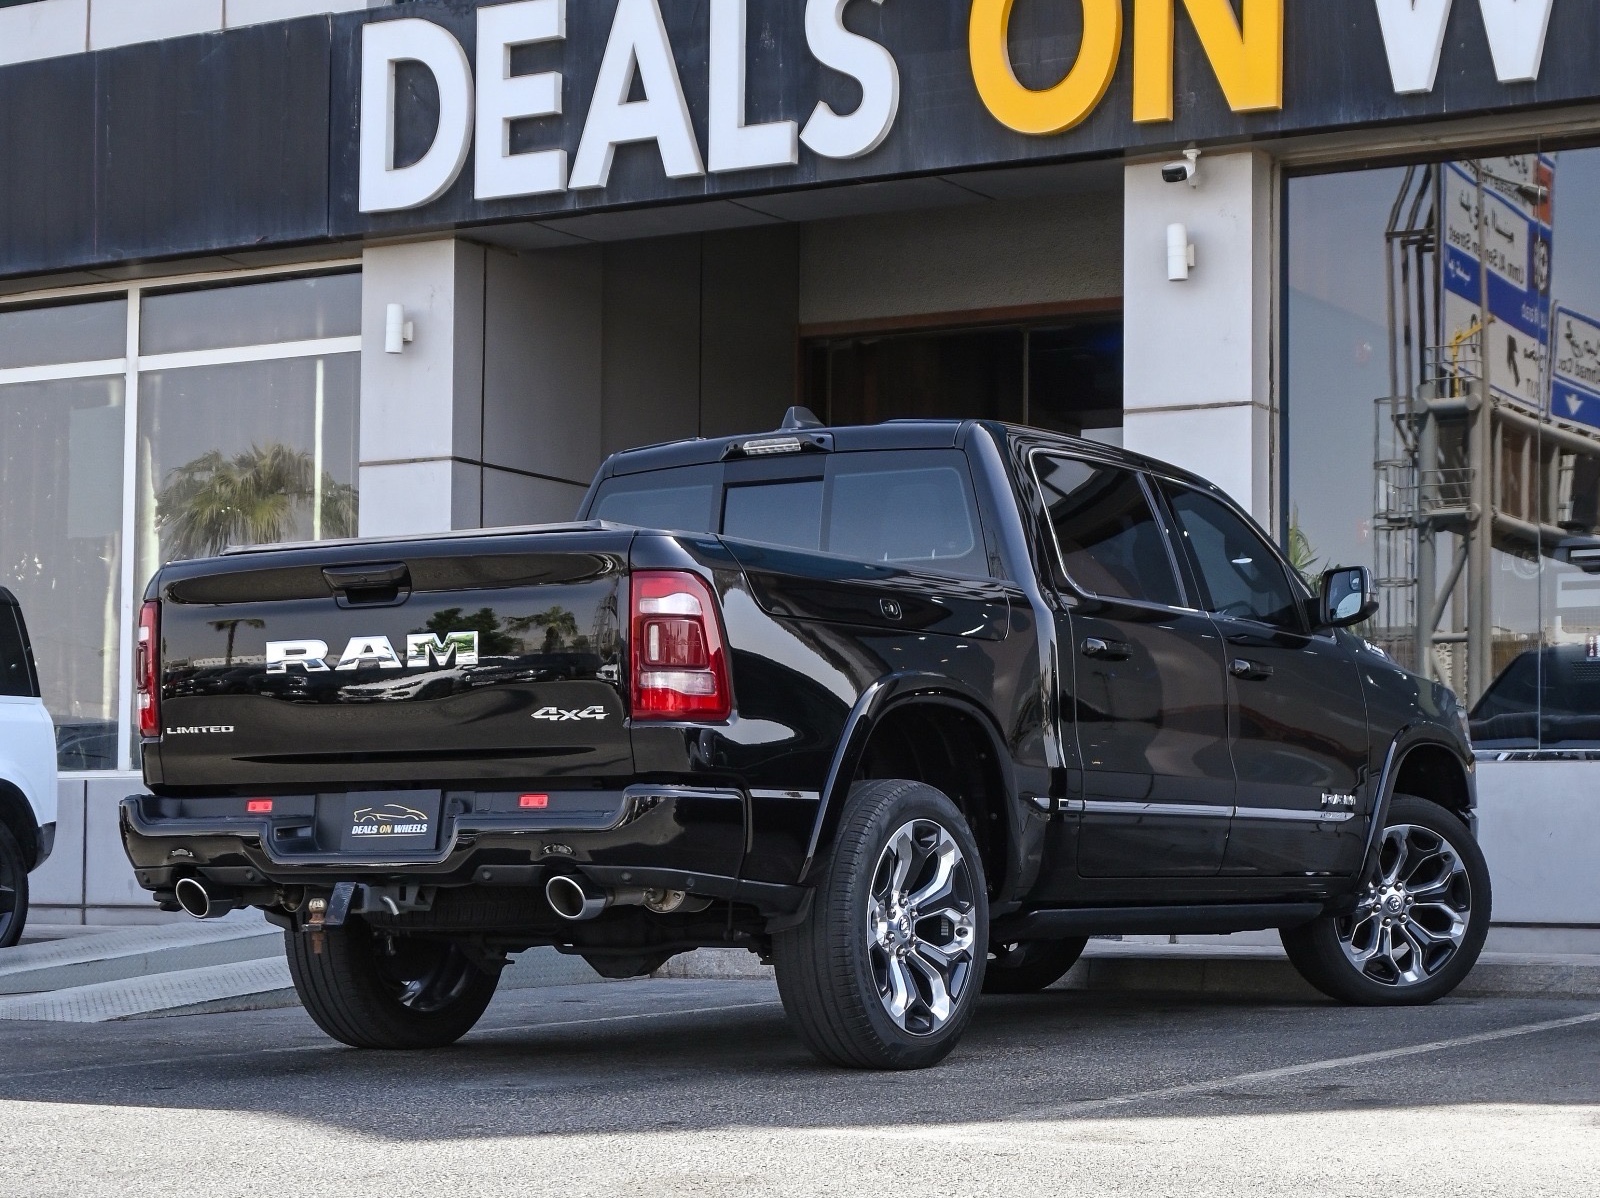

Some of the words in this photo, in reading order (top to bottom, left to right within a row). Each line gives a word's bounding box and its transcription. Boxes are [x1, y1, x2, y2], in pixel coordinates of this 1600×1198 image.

[358, 0, 901, 213] DEALS
[968, 0, 1283, 136] ON
[265, 630, 480, 674] RAM
[530, 705, 610, 721] 4x4
[166, 725, 235, 735] LIMITED
[1321, 793, 1356, 805] RAM
[351, 825, 378, 835] DEALS
[379, 824, 393, 834] ON
[393, 823, 428, 834] WHEELS
